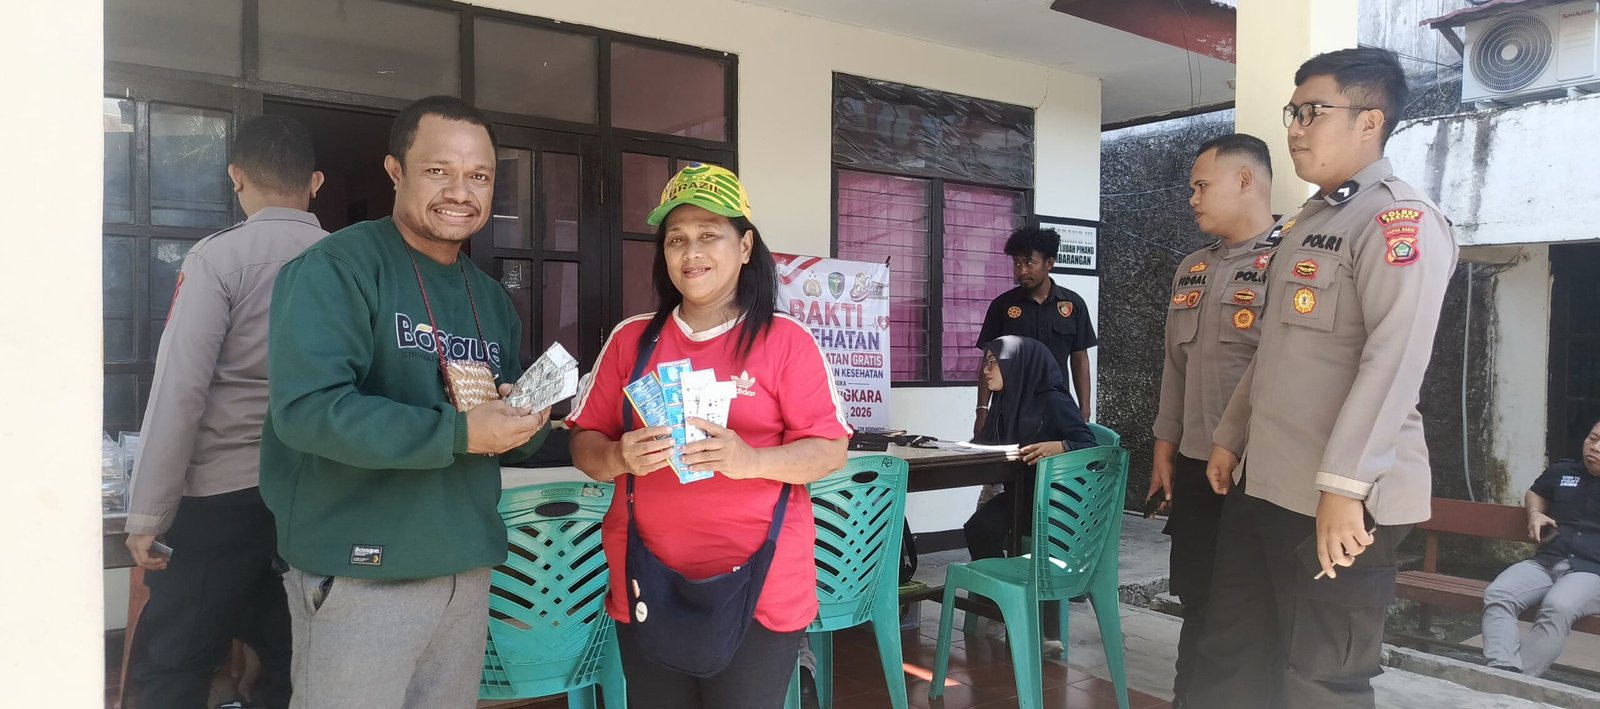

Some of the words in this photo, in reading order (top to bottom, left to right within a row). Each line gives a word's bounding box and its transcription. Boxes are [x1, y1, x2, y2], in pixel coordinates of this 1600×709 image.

[1562, 8, 1594, 19] SHARP
[669, 181, 722, 199] BRAZIL
[1381, 209, 1419, 221] POLRES
[1302, 234, 1342, 252] POLRI
[1060, 244, 1075, 253] LUDAH
[1077, 245, 1094, 255] PINANG
[1056, 254, 1091, 265] BARANGAN
[789, 298, 864, 329] BAKTI
[852, 354, 882, 368] GRATIS
[841, 368, 884, 379] KESEHATAN
[850, 406, 872, 418] 2026
